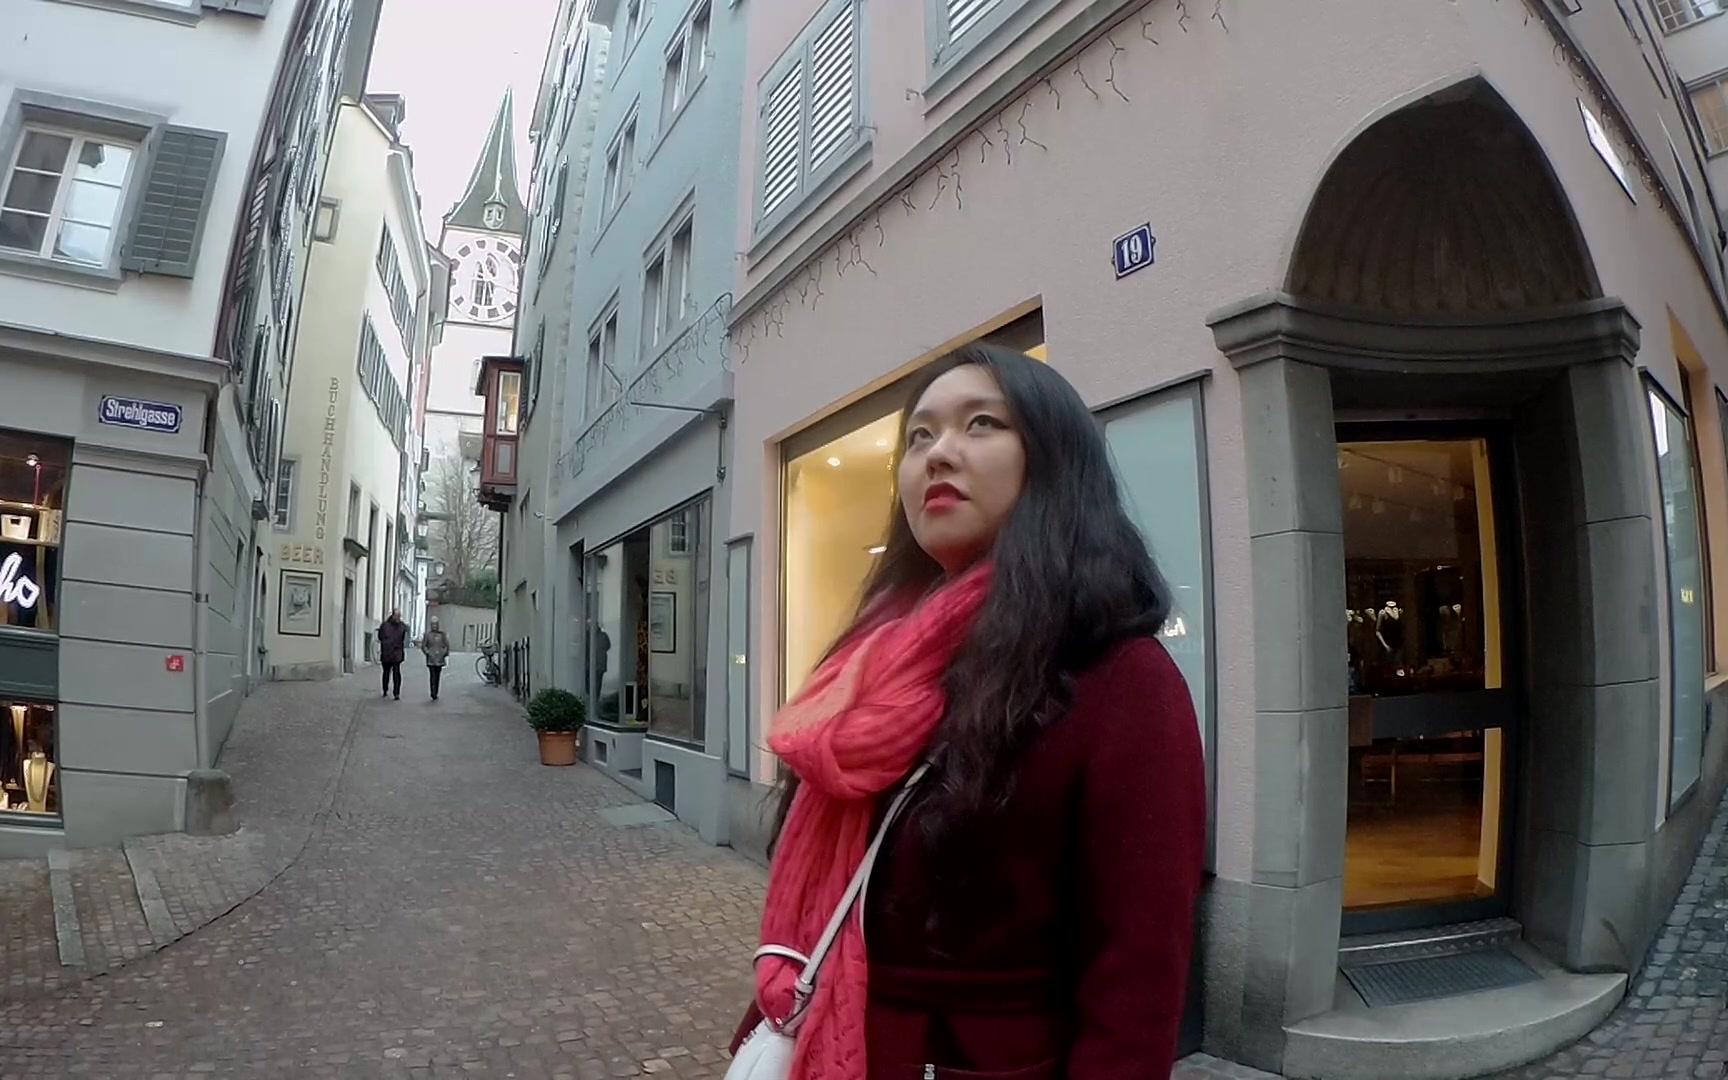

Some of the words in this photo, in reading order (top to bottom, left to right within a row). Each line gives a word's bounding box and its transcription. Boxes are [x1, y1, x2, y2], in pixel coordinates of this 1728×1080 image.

[1120, 234, 1143, 269] 19
[105, 399, 176, 426] Strehlgasse
[315, 376, 339, 539] BUCHHANDLUNG
